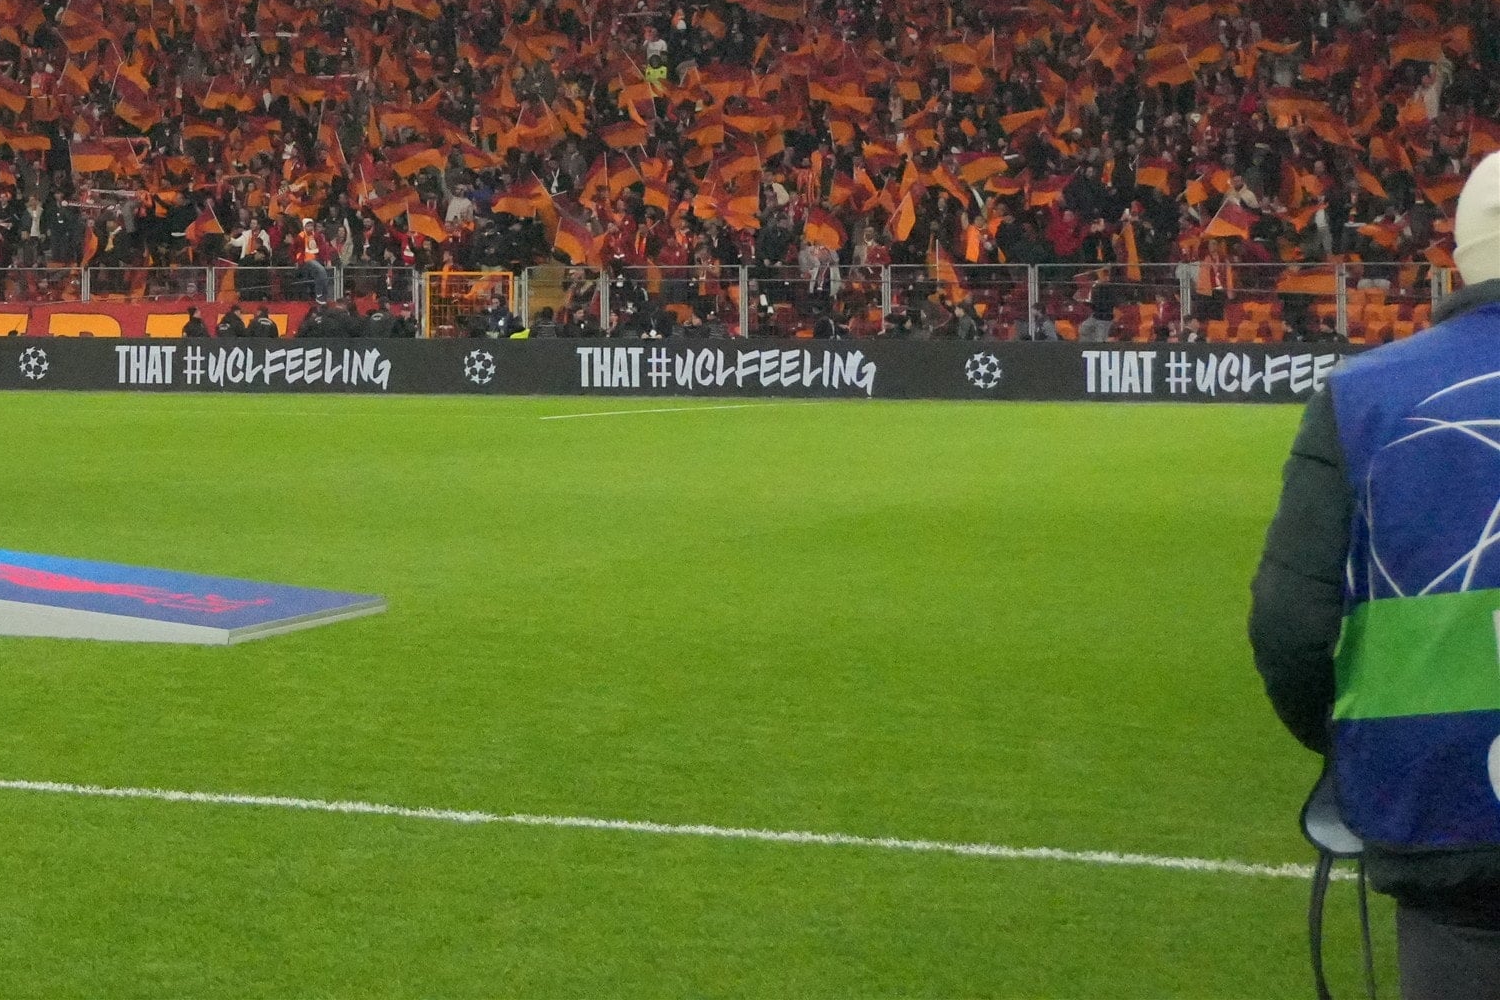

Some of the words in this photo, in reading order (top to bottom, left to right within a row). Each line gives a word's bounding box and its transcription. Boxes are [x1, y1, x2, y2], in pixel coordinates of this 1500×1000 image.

[115, 345, 177, 384] THAT
[182, 345, 391, 390] #UCLFEELING
[576, 347, 644, 388] THAT
[647, 347, 877, 397] #UCLFEELING
[1082, 350, 1157, 393] THAT
[1164, 351, 1343, 396] #UCLFEE
